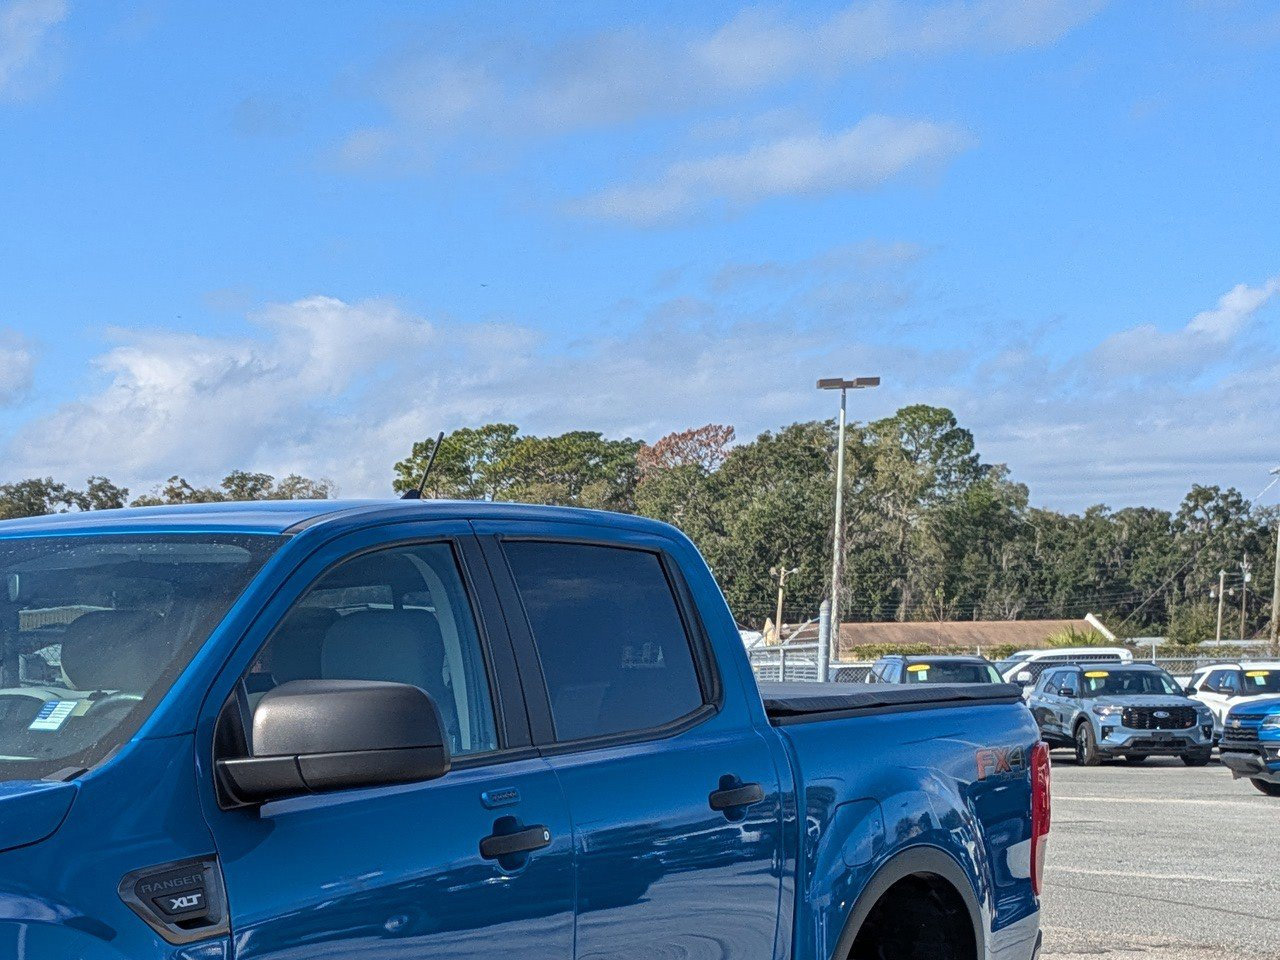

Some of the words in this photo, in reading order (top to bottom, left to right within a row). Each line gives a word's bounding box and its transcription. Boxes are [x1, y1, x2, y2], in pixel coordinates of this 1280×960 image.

[975, 744, 1026, 782] FX4
[141, 874, 203, 893] RANGER
[169, 893, 202, 910] XLT
